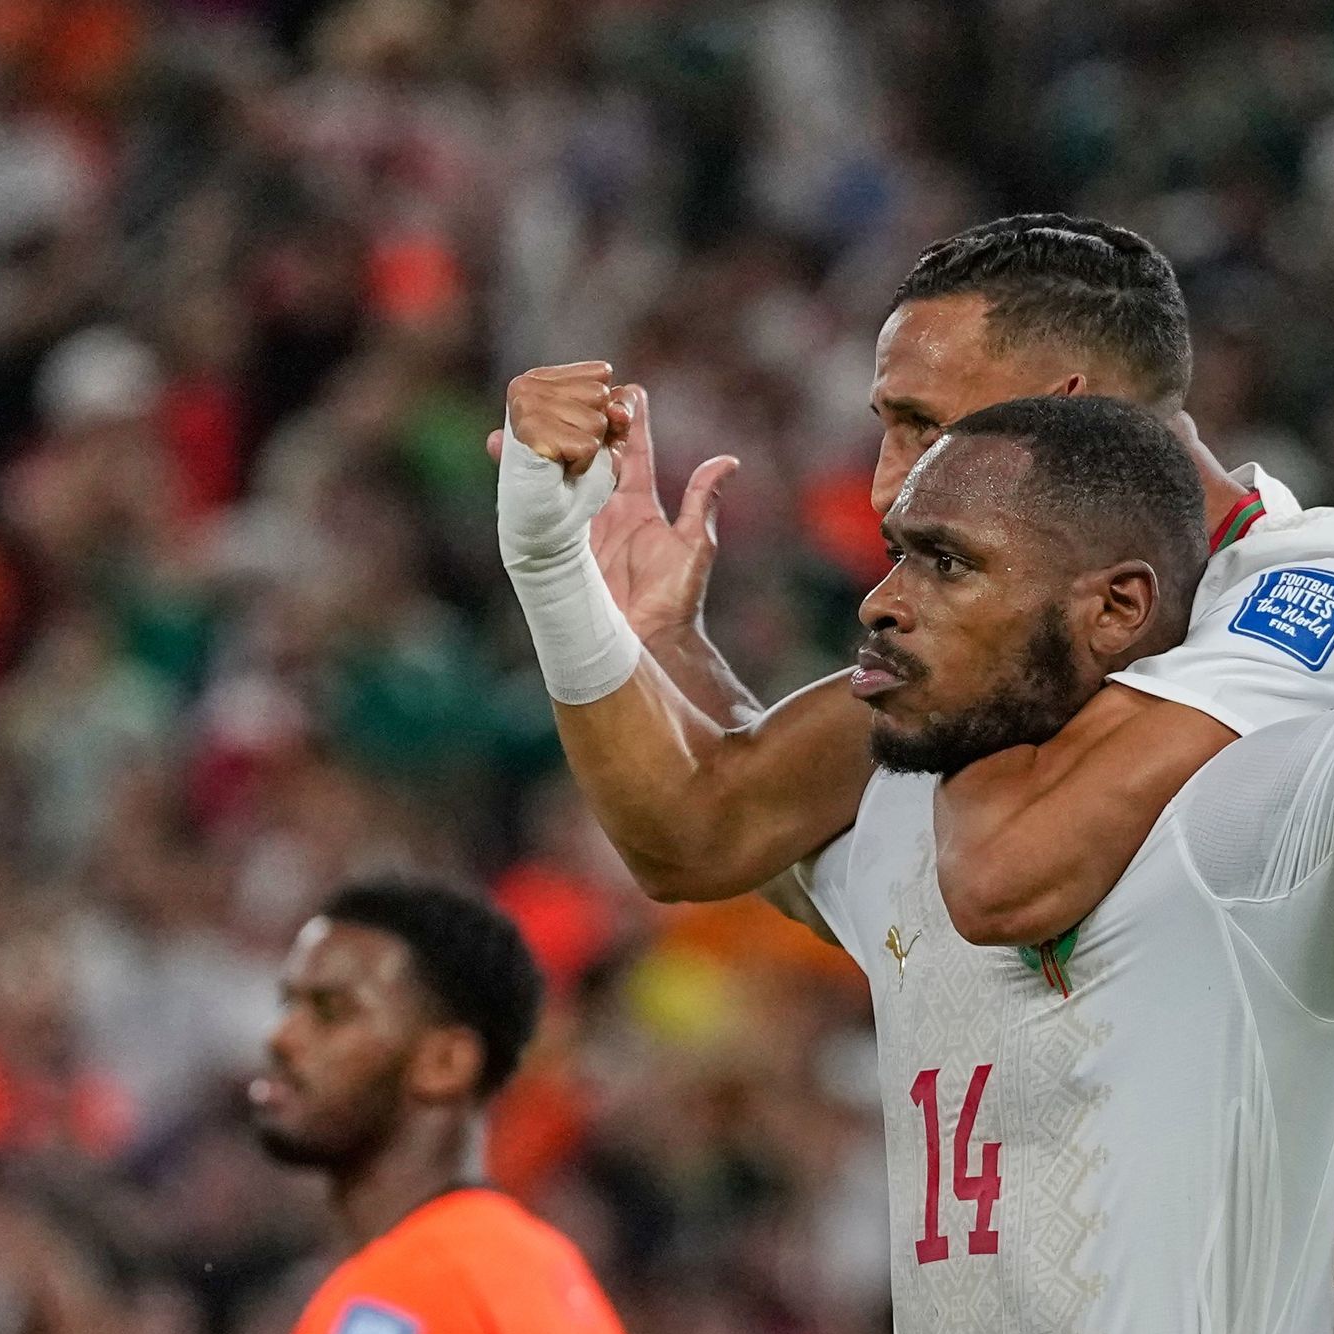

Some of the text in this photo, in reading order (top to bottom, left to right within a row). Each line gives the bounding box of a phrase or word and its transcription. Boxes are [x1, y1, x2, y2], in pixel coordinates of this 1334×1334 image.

[1256, 598, 1331, 639] the World
[1268, 618, 1297, 638] FIFA
[910, 1063, 1002, 1265] 14
